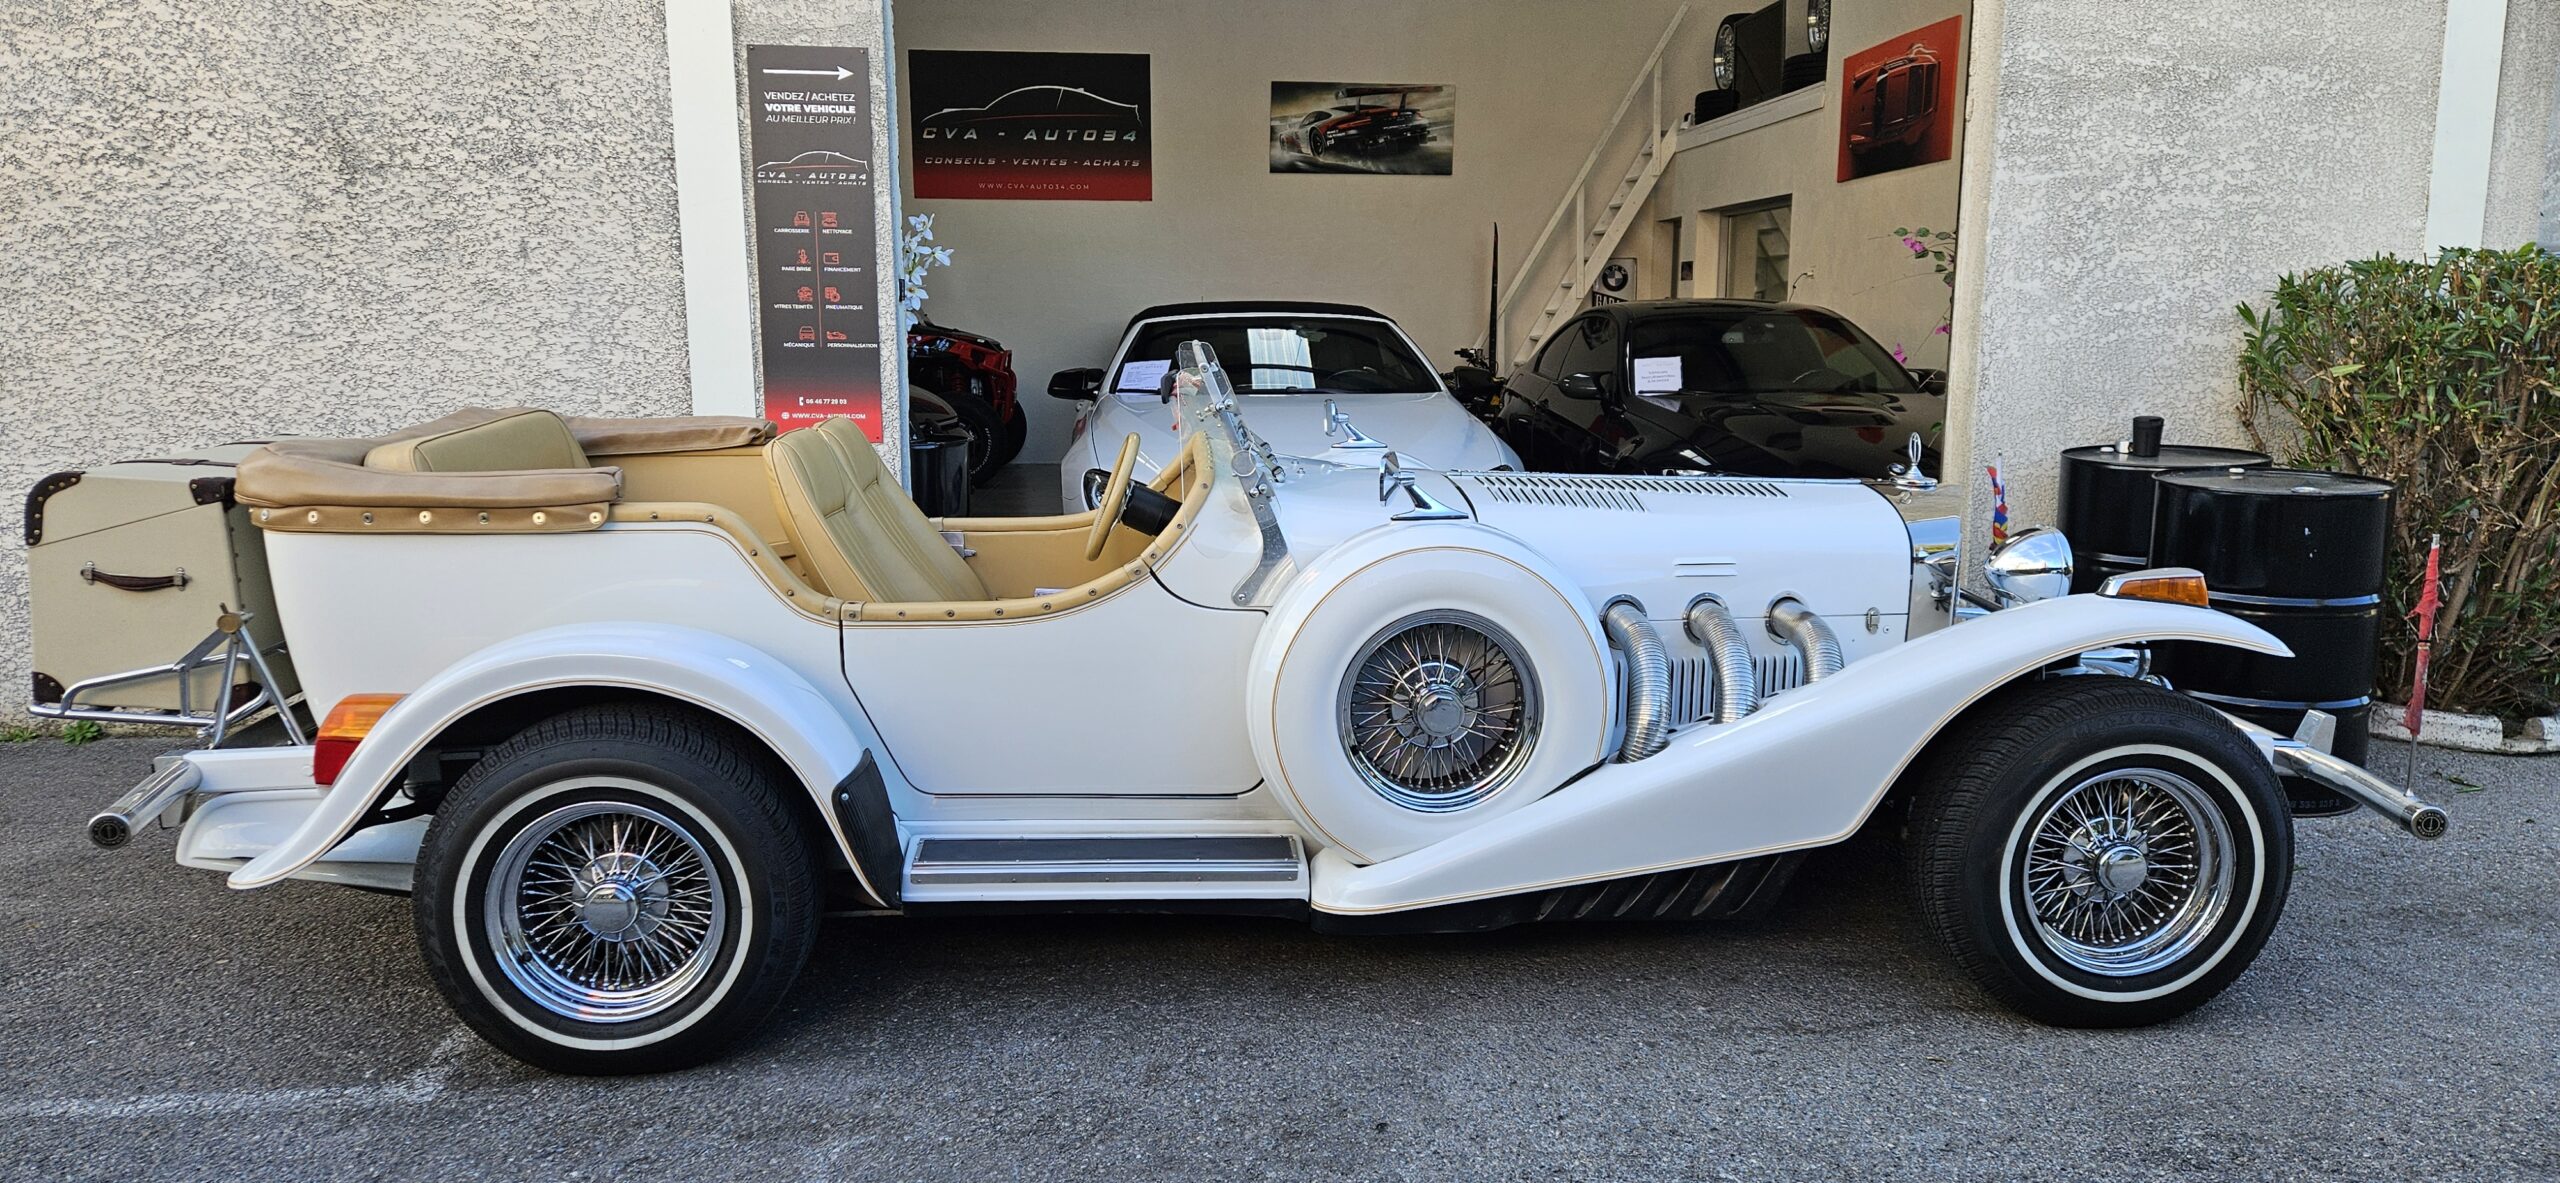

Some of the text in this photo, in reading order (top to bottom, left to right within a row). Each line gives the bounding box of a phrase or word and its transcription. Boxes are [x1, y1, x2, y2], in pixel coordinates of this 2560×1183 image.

[764, 91, 855, 102] VENDEZ / ACHETEZ
[765, 103, 856, 114] VOTRE VEHICULE
[765, 115, 780, 123] AU
[782, 115, 829, 124] MEILLEUR
[922, 127, 978, 140] CVA
[1023, 129, 1137, 142] AUTO34
[924, 156, 996, 165] CONSEILS
[1012, 158, 1069, 167] VENTES
[1083, 159, 1141, 167] ACHATS
[808, 172, 867, 180] AUTO34
[978, 182, 1090, 191] WWW.CVA-AUTO34.COM
